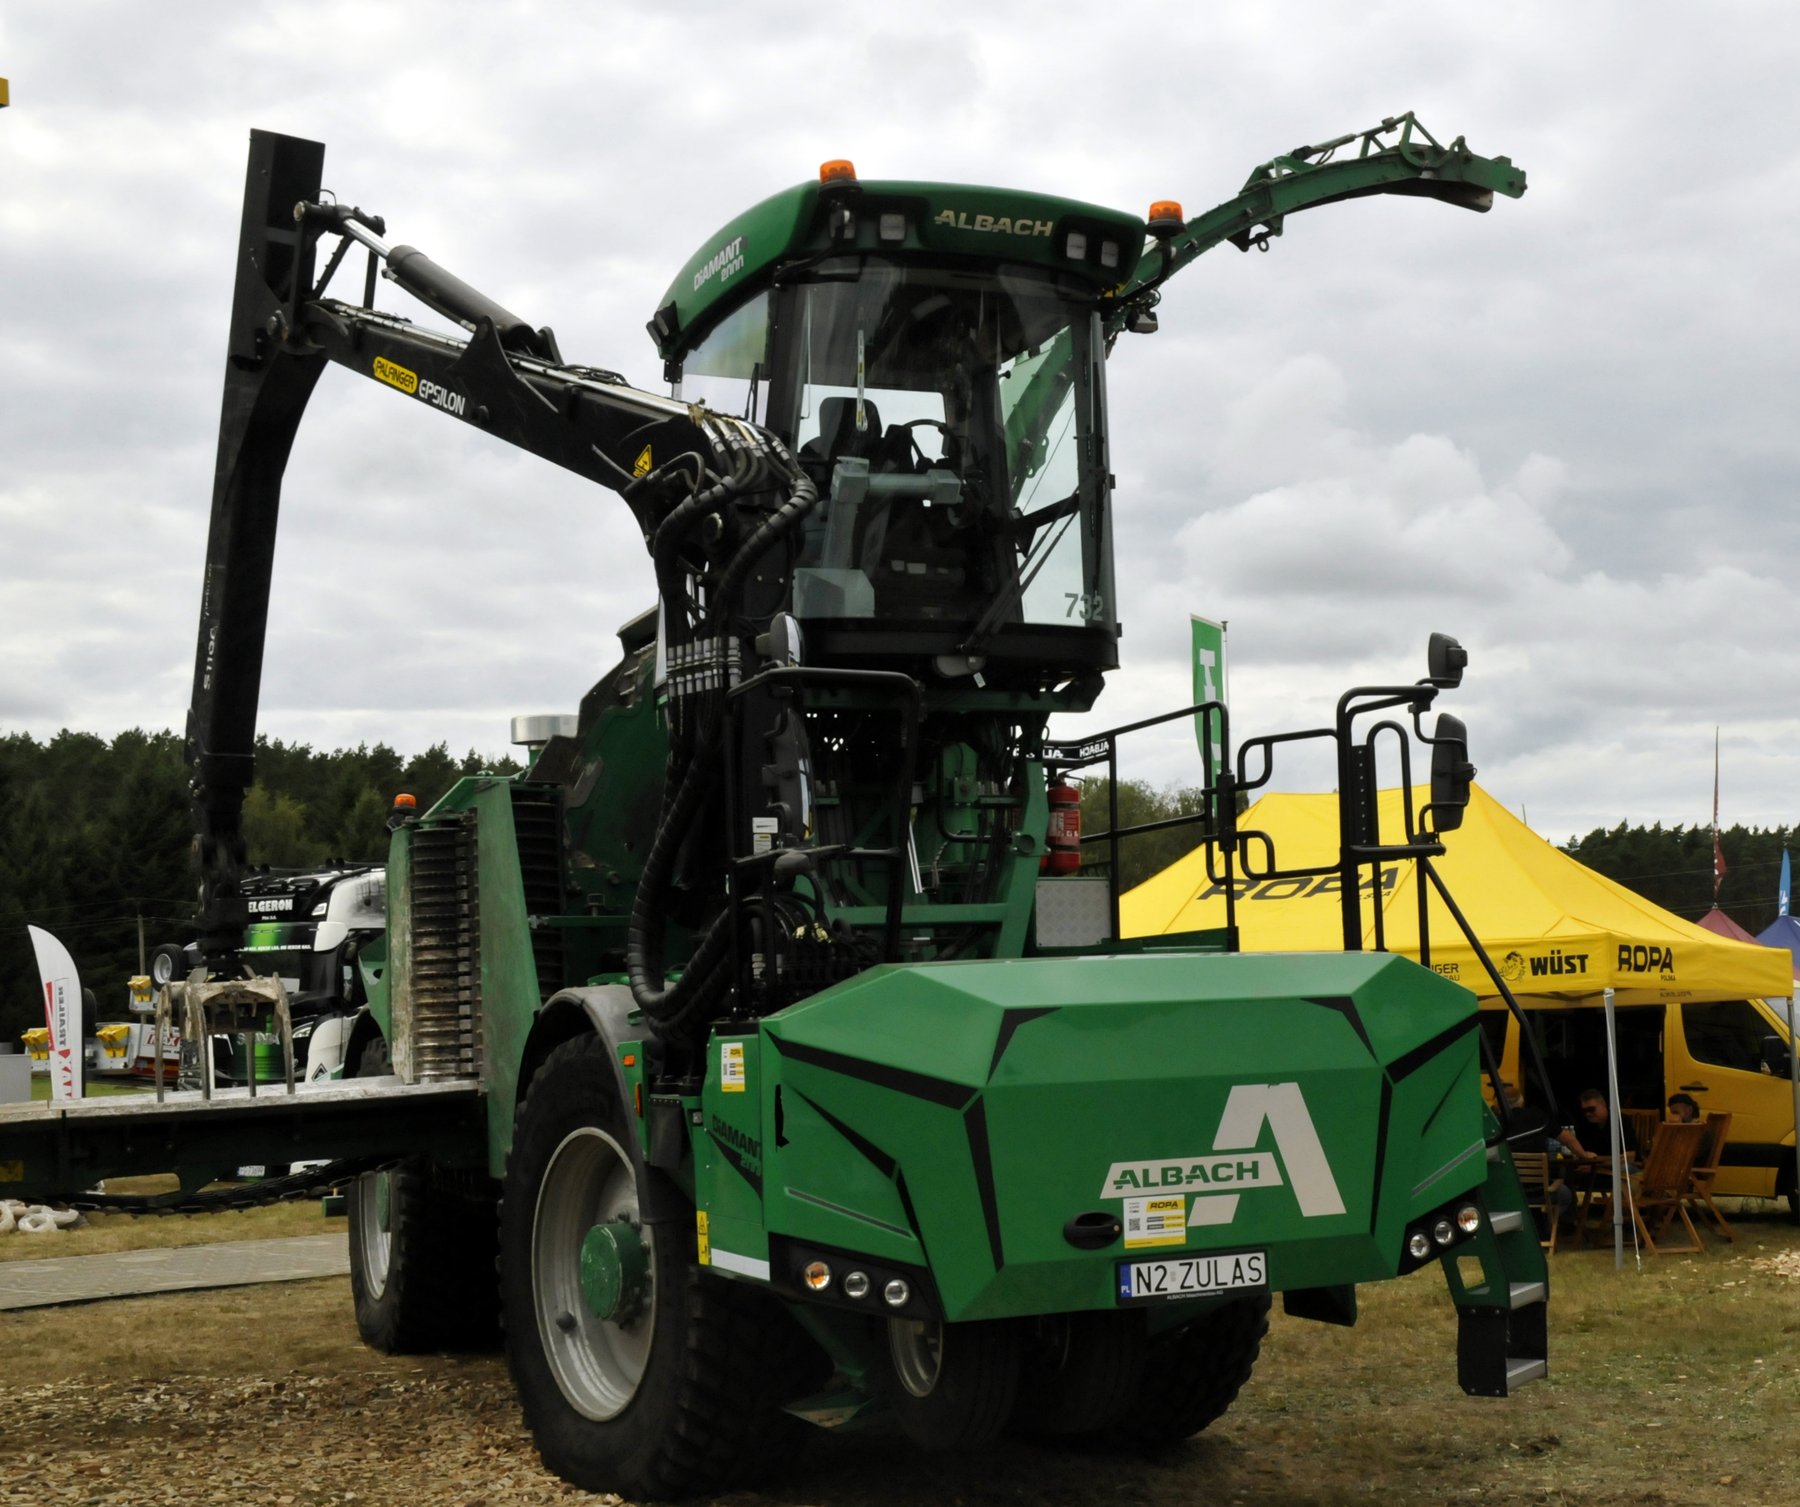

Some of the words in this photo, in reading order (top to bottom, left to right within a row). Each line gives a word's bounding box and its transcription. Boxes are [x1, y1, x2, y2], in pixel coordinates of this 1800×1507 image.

[934, 210, 1054, 237] ALBACH
[374, 360, 415, 390] PALFINGER
[419, 378, 466, 416] EPSILON
[1064, 592, 1104, 621] 732
[1529, 949, 1589, 977] WÜST
[1617, 944, 1675, 974] ROPA
[1113, 1160, 1260, 1190] ALBACH
[1150, 1201, 1179, 1209] ROPA
[1136, 1264, 1168, 1294] N2
[1179, 1255, 1263, 1290] ZULAS
